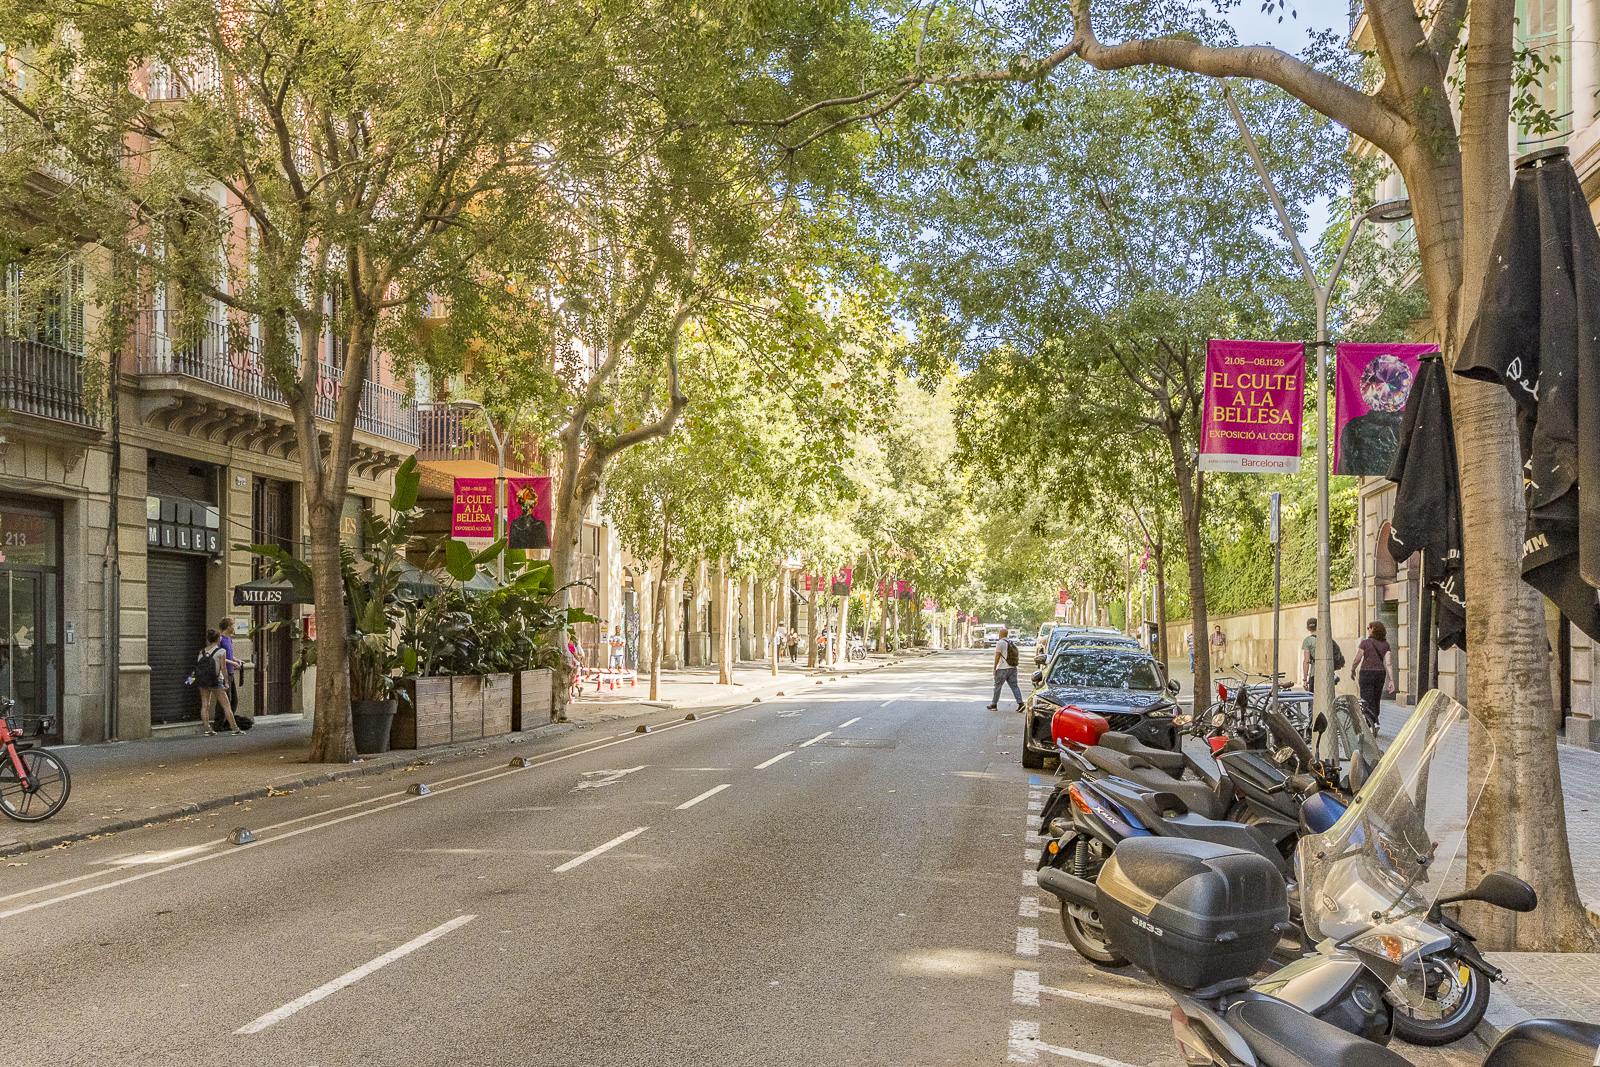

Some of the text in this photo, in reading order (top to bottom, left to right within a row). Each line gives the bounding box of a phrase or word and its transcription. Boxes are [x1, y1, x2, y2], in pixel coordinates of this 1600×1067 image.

[1212, 372, 1297, 391] EL CULTE
[1232, 390, 1274, 407] A LA
[1213, 406, 1294, 425] BELLESA
[1209, 430, 1295, 441] EXPOSICIÓ AL CCCB
[1241, 457, 1284, 468] Barcelona
[456, 494, 492, 504] EL CULTE
[465, 504, 483, 513] A LA
[456, 513, 491, 523] BELLESA
[5, 531, 26, 547] 213
[148, 527, 216, 550] MILES
[242, 590, 282, 602] MILES
[1151, 633, 1158, 642] P
[1131, 915, 1164, 937] SH33
